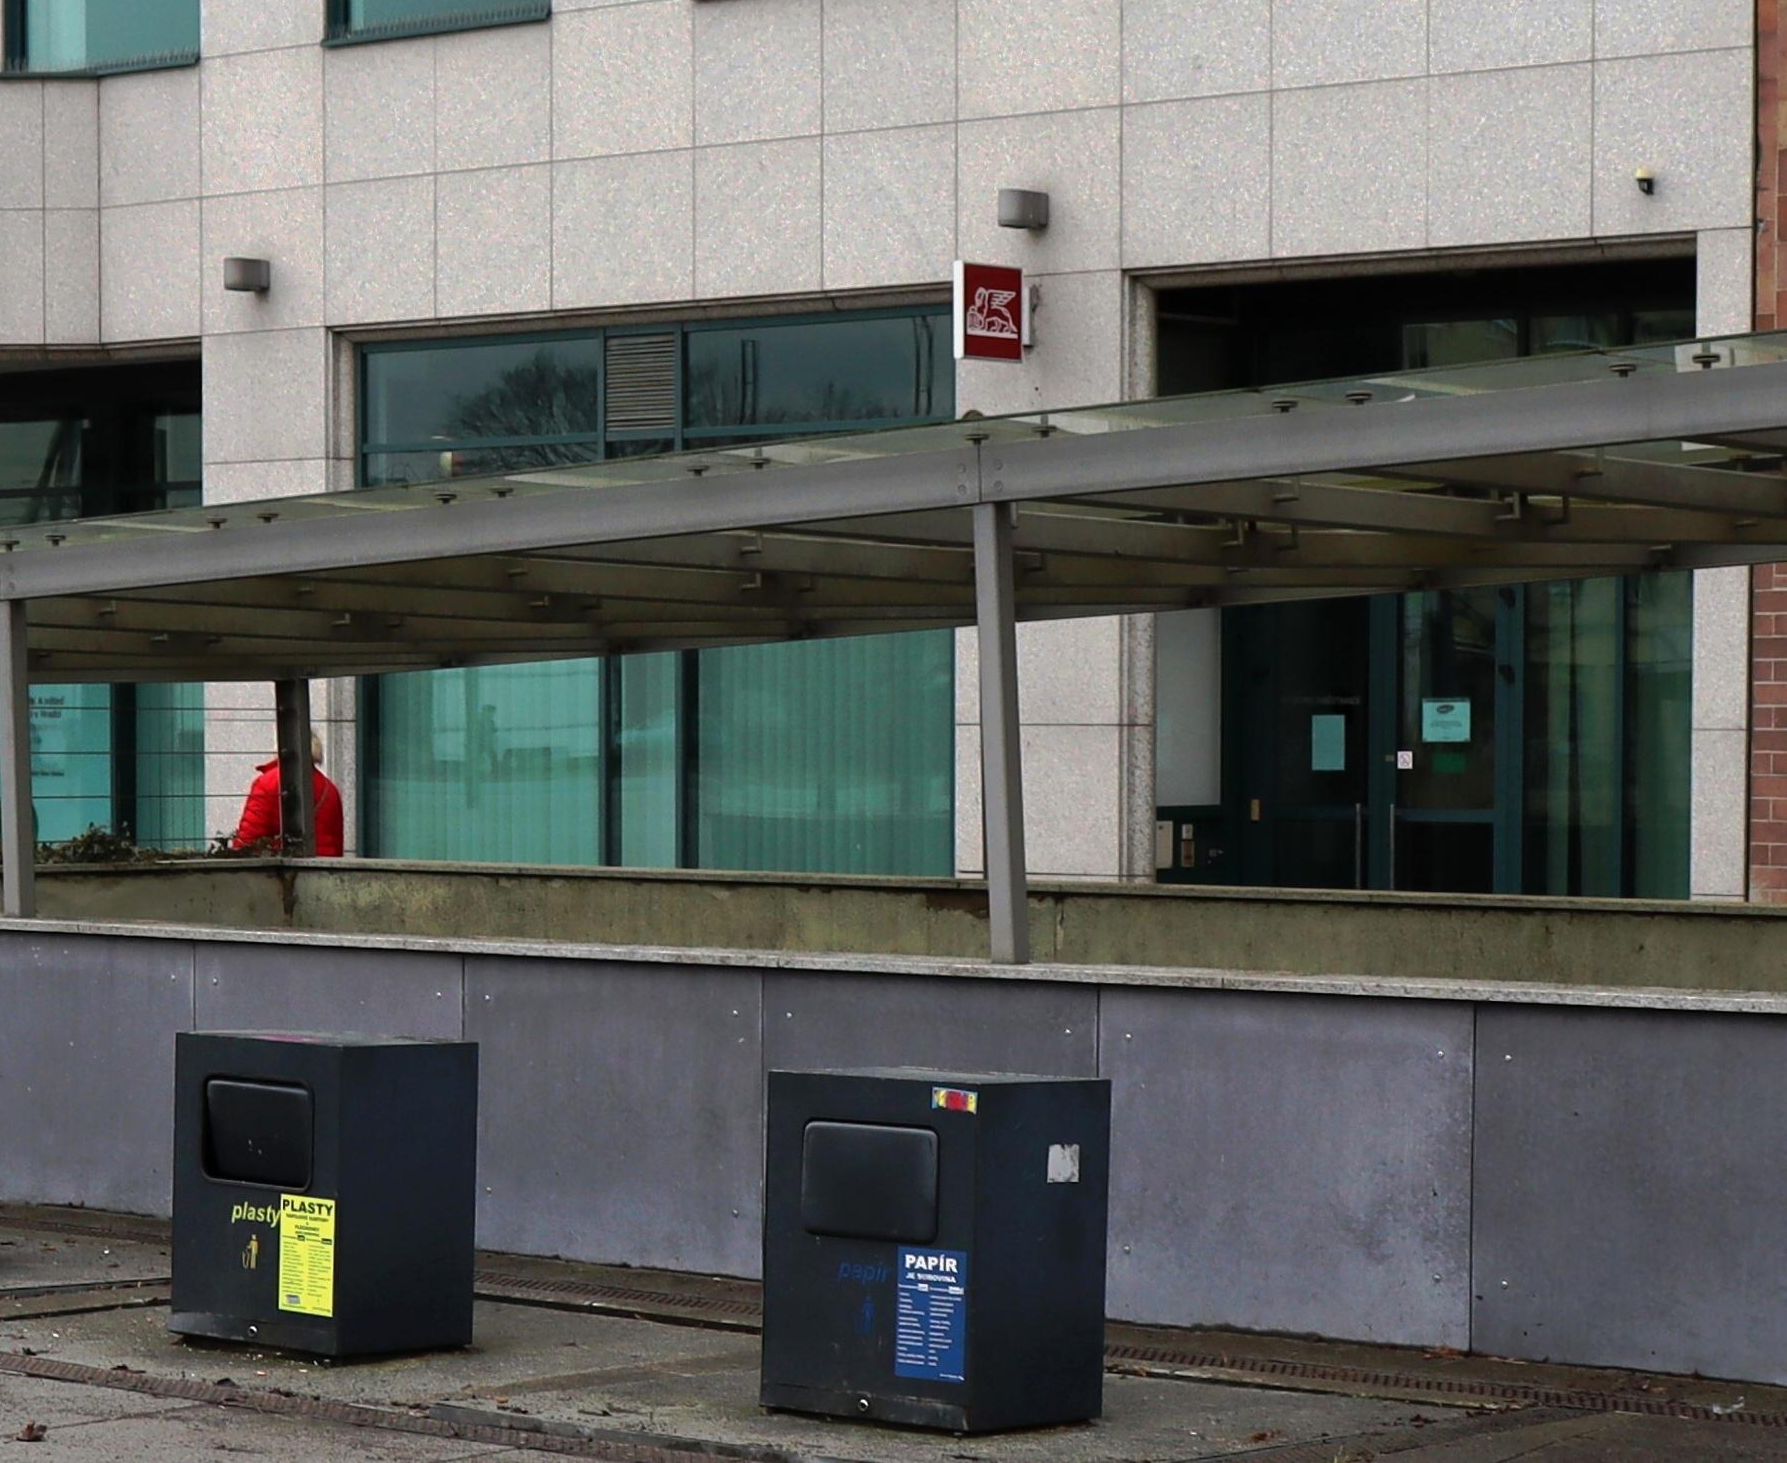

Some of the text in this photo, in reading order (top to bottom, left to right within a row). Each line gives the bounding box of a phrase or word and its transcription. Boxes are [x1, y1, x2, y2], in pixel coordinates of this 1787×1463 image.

[231, 1201, 281, 1228] plasty
[282, 1199, 334, 1217] PLASTY
[904, 1253, 959, 1274] PAPÍR
